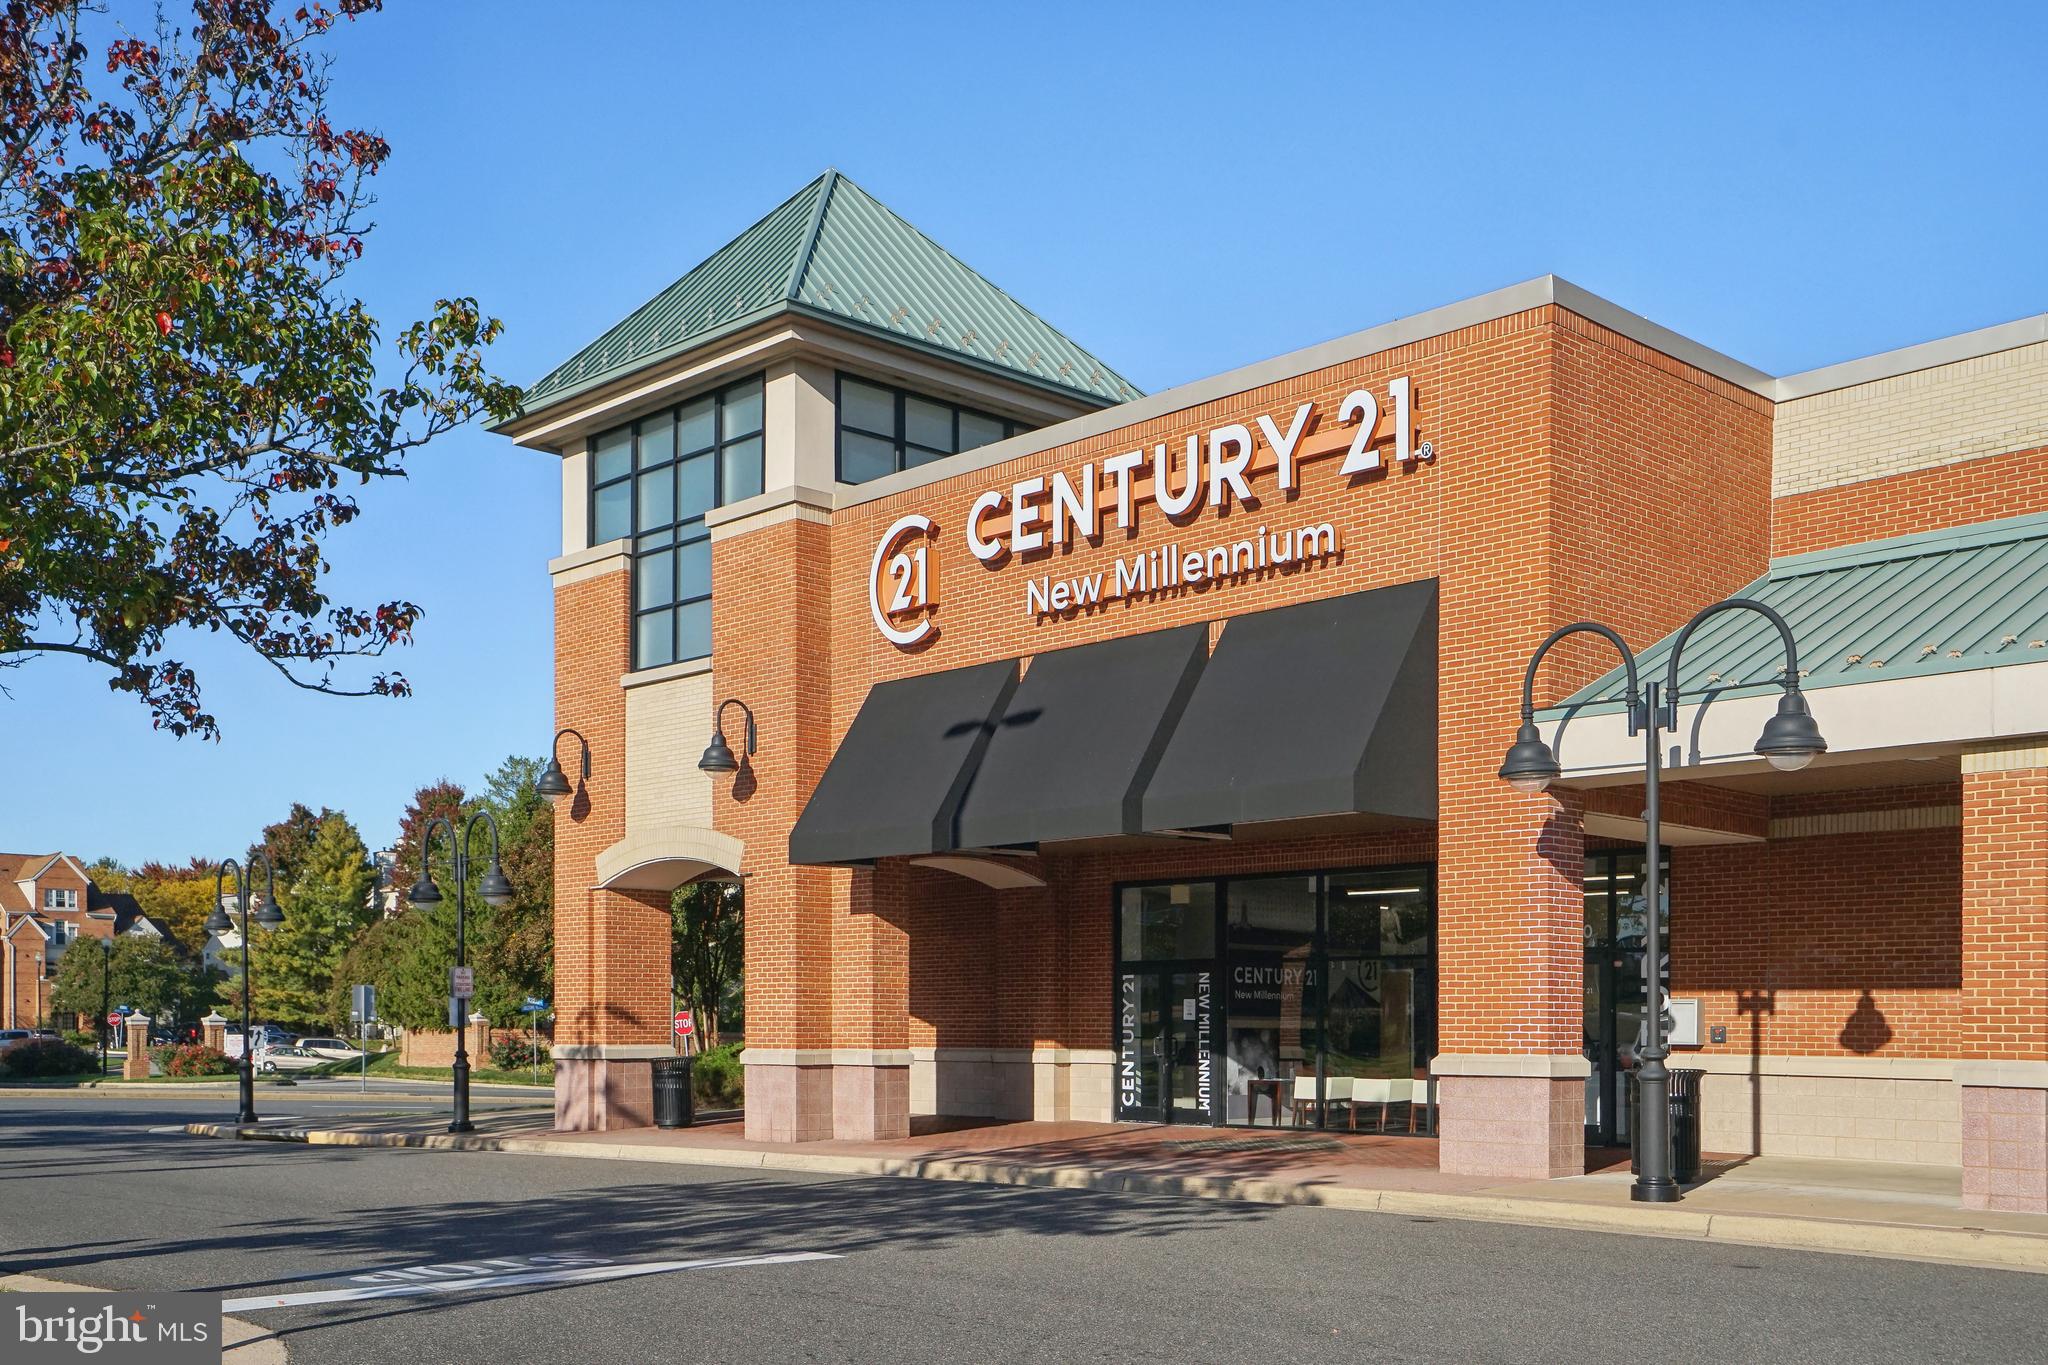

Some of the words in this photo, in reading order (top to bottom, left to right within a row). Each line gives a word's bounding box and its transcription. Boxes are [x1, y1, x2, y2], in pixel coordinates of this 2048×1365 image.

[966, 402, 1315, 560] CENTURY
[1026, 571, 1105, 616] New
[1114, 520, 1338, 599] Millennium
[1122, 974, 1135, 993] 21
[1198, 972, 1211, 1009] NEW
[1234, 966, 1303, 984] CENTURY
[1305, 969, 1317, 986] 21
[1234, 990, 1251, 999] New
[1253, 991, 1294, 1000] Millennium
[1121, 999, 1135, 1107] CENTURY
[1198, 1013, 1211, 1111] MILLENNIUM
